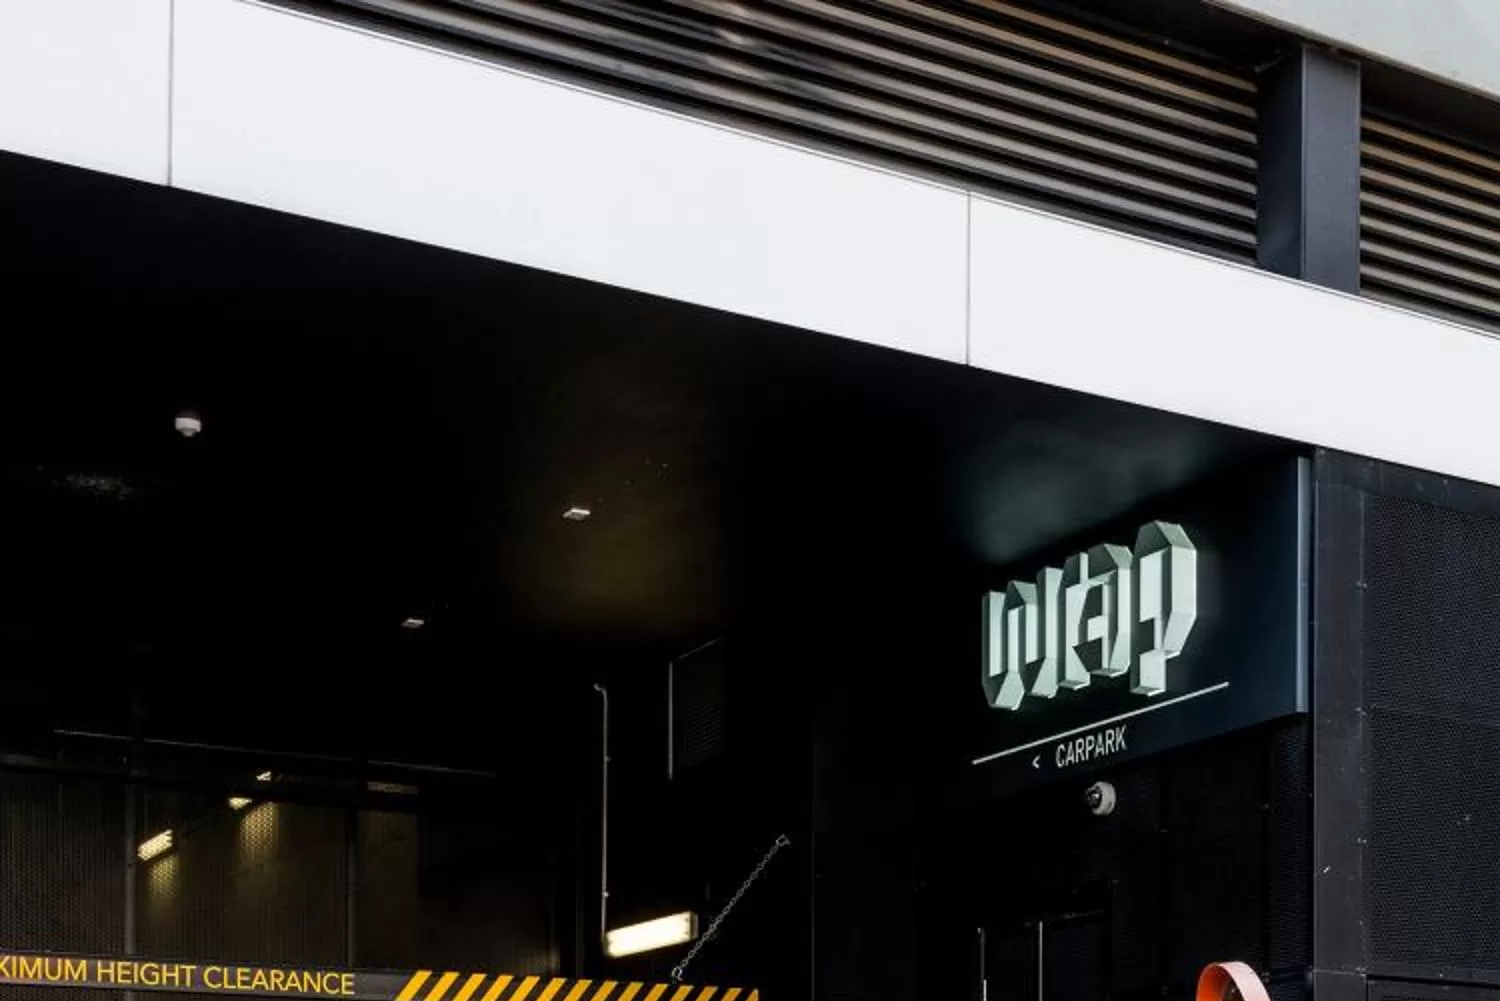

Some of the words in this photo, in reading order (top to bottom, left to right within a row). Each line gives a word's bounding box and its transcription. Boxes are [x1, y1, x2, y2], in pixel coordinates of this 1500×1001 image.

[1055, 723, 1127, 768] CARPARK
[97, 959, 197, 987] HEIGHT
[203, 965, 355, 995] CLEARANCE
